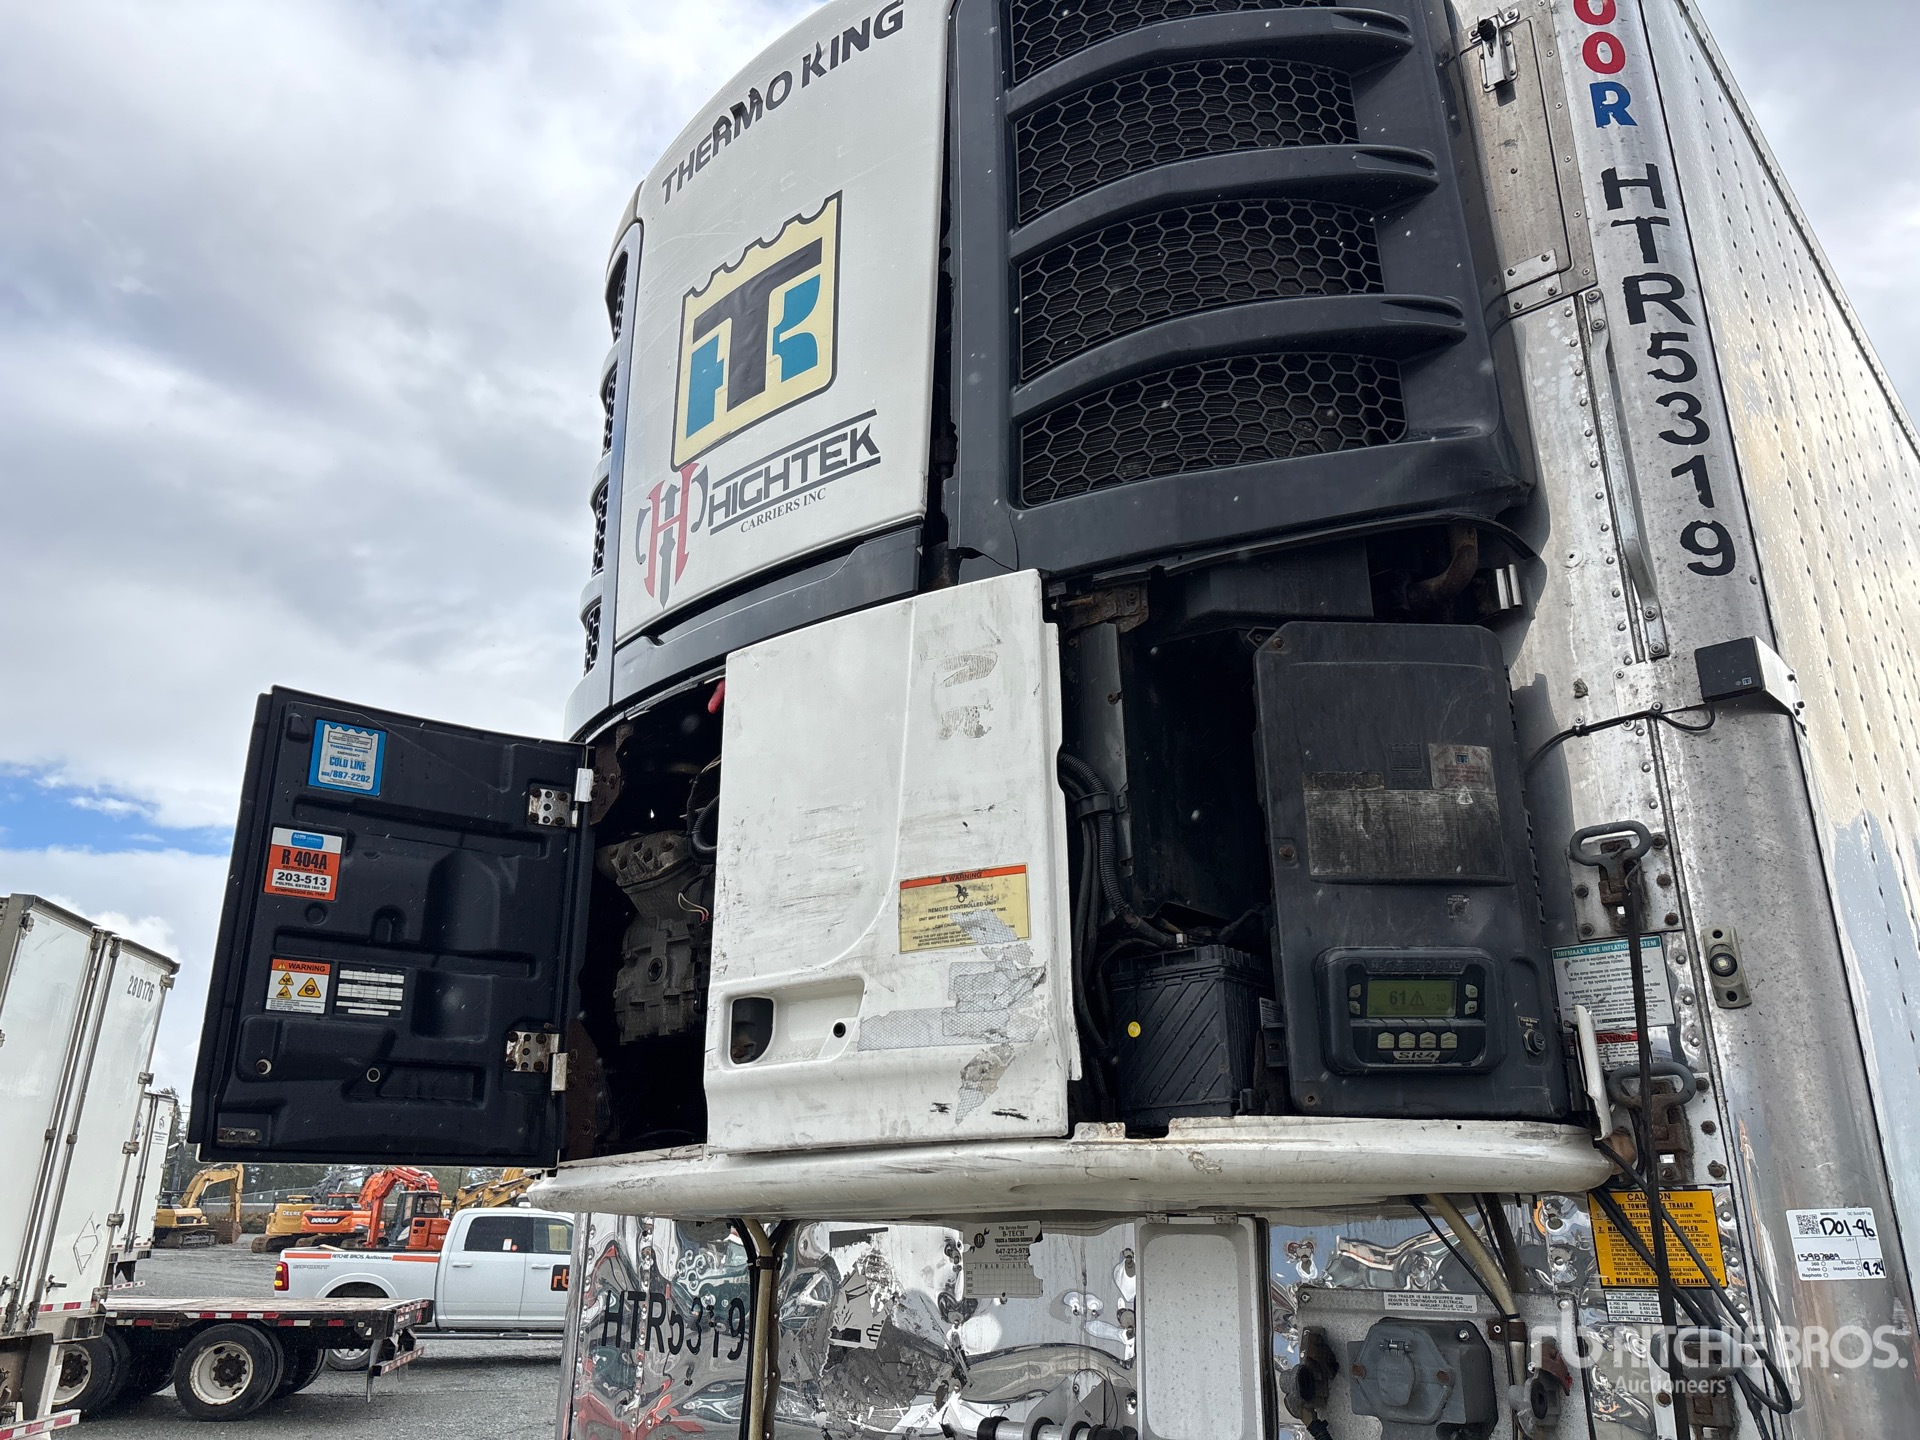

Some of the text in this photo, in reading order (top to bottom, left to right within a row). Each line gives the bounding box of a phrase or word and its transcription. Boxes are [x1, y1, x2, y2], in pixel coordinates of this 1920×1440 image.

[662, 0, 905, 206] THERMO KING
[1601, 162, 1736, 577] HTR5319
[708, 422, 880, 528] HIGHTEK
[740, 487, 828, 533] CARRIERS INC
[330, 755, 366, 772] COLD LINE
[281, 848, 328, 870] R 404A
[276, 872, 327, 886] 203-513
[949, 872, 982, 882] WARNING
[950, 902, 984, 910] CONTROLLED
[1640, 939, 1657, 948] STEM
[288, 962, 326, 972] WARNING
[1389, 990, 1406, 1005] 61
[1627, 1192, 1671, 1200] CAUON
